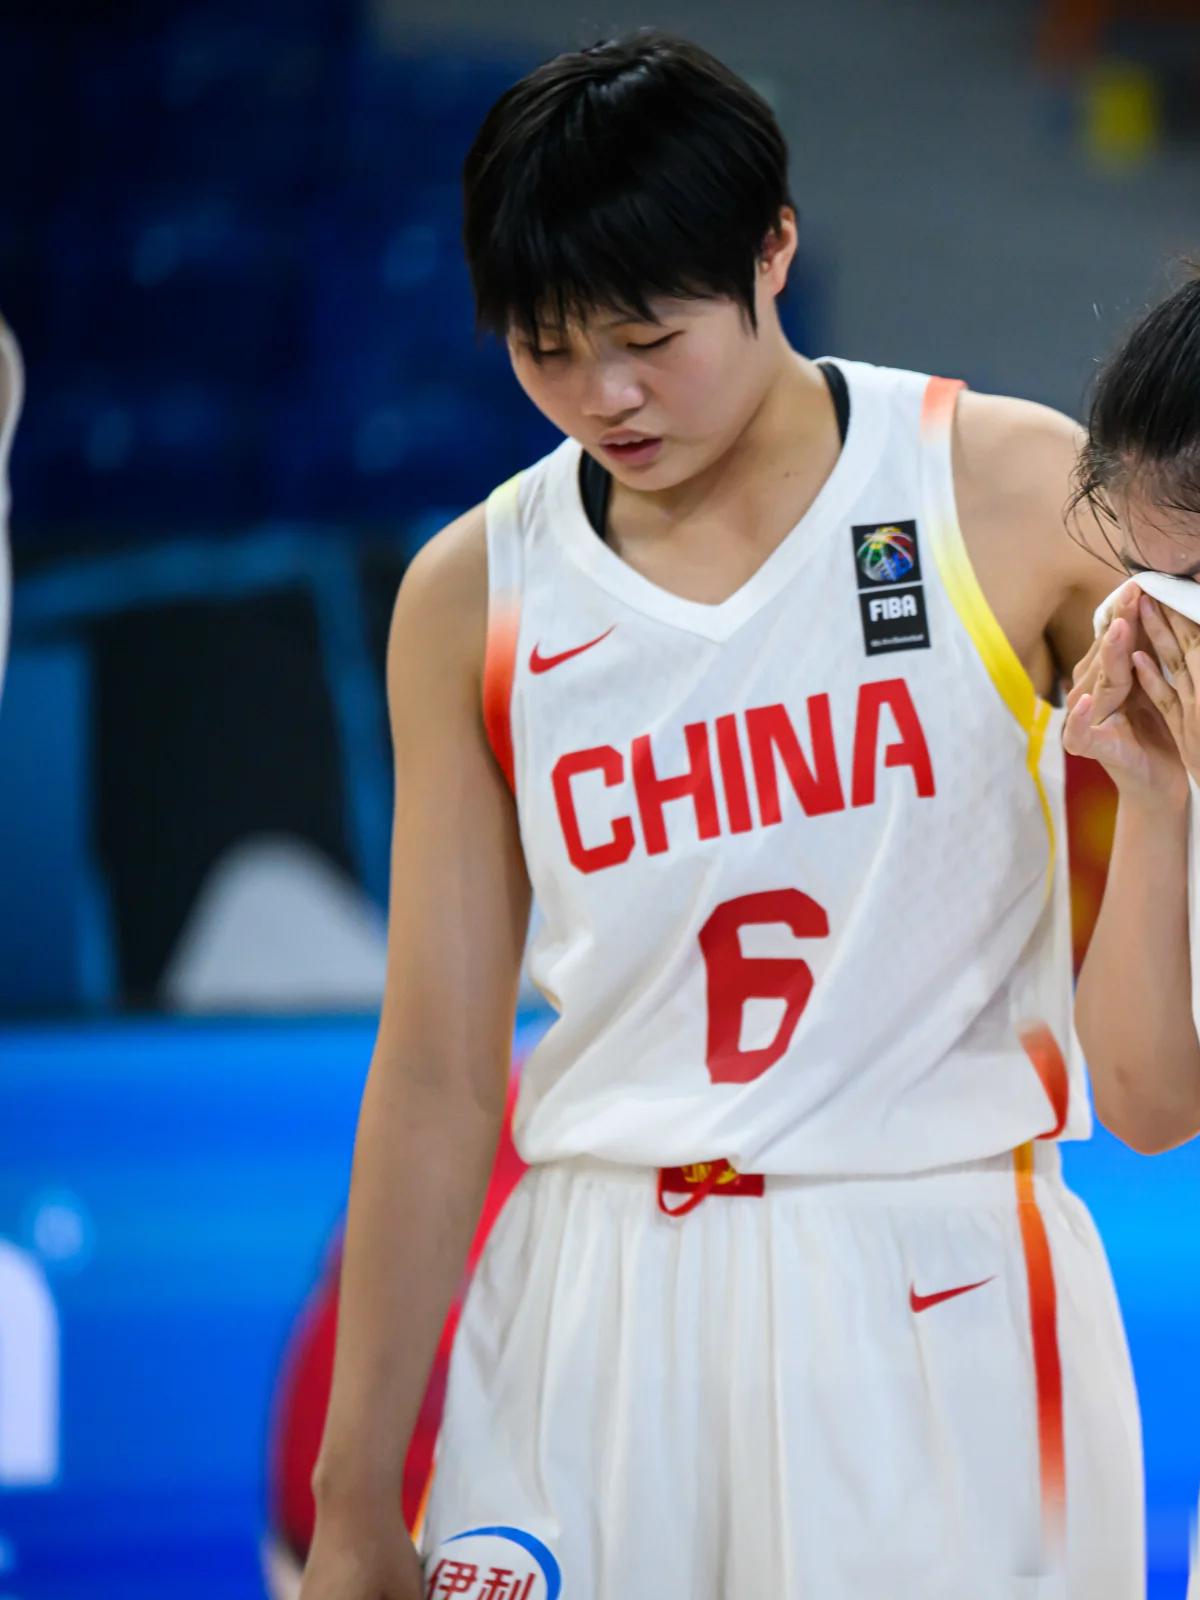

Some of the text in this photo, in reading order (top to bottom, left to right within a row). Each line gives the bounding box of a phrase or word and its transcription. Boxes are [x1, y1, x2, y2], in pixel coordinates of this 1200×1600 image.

[869, 594, 918, 622] FIBA
[551, 678, 936, 875] CHINA
[697, 887, 830, 1085] 6
[427, 1558, 536, 1600] 伊利
